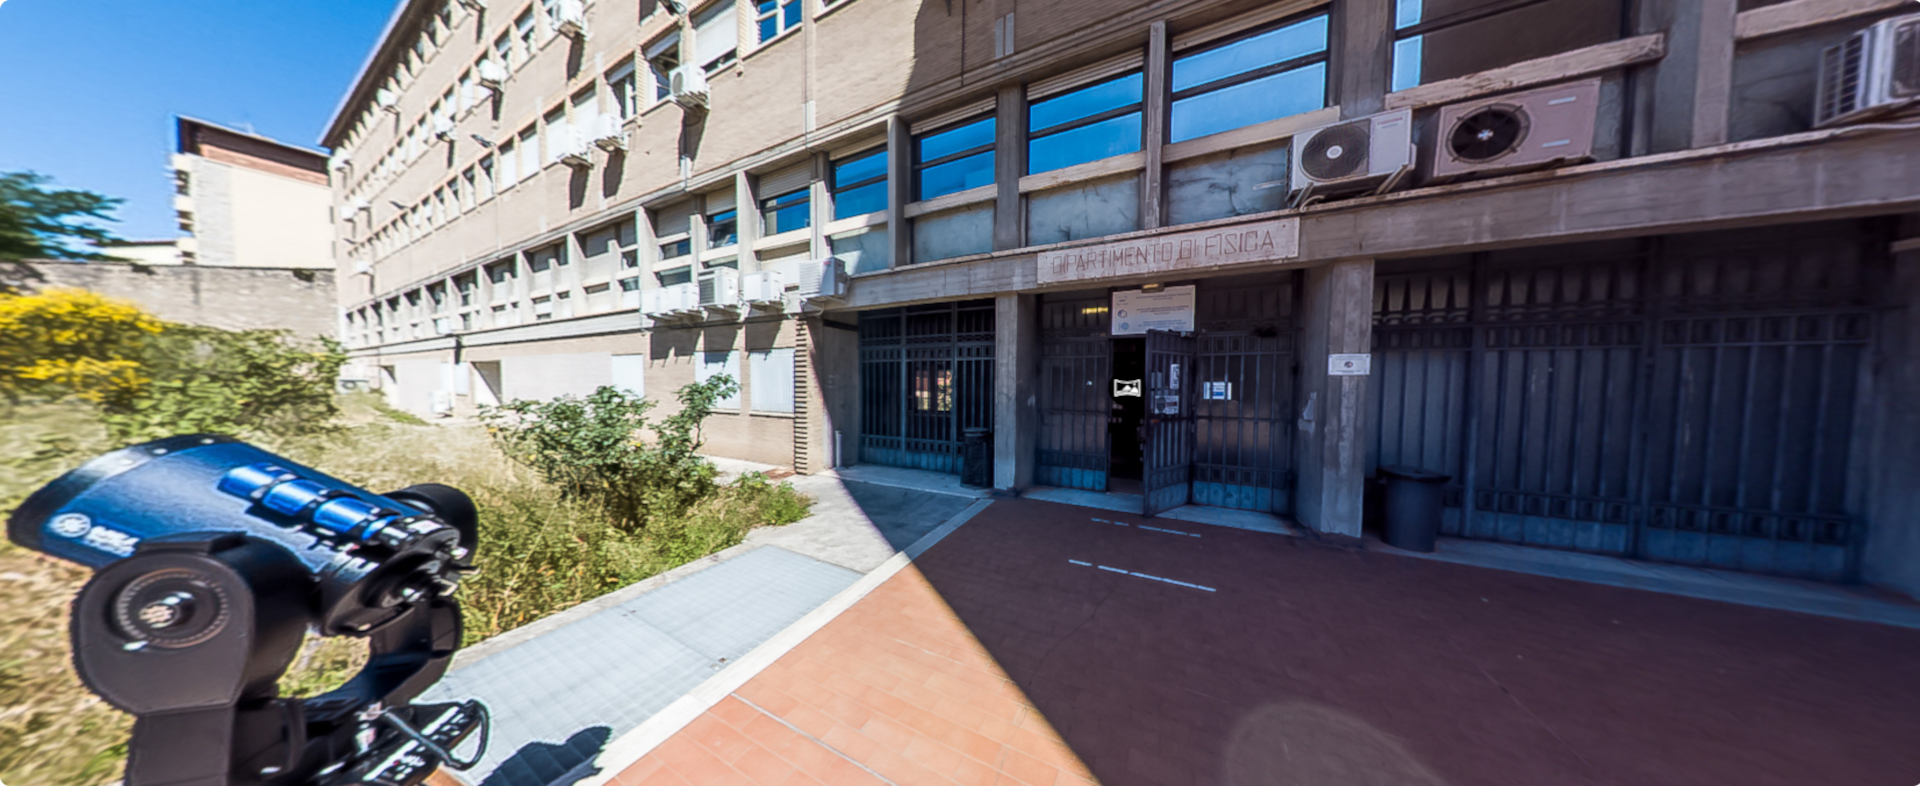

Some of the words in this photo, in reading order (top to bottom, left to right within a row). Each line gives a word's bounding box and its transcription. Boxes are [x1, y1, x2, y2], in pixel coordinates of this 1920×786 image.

[1052, 242, 1173, 274] DIPARTIMENTO
[1179, 239, 1197, 260] DI
[1204, 229, 1275, 257] FISICA
